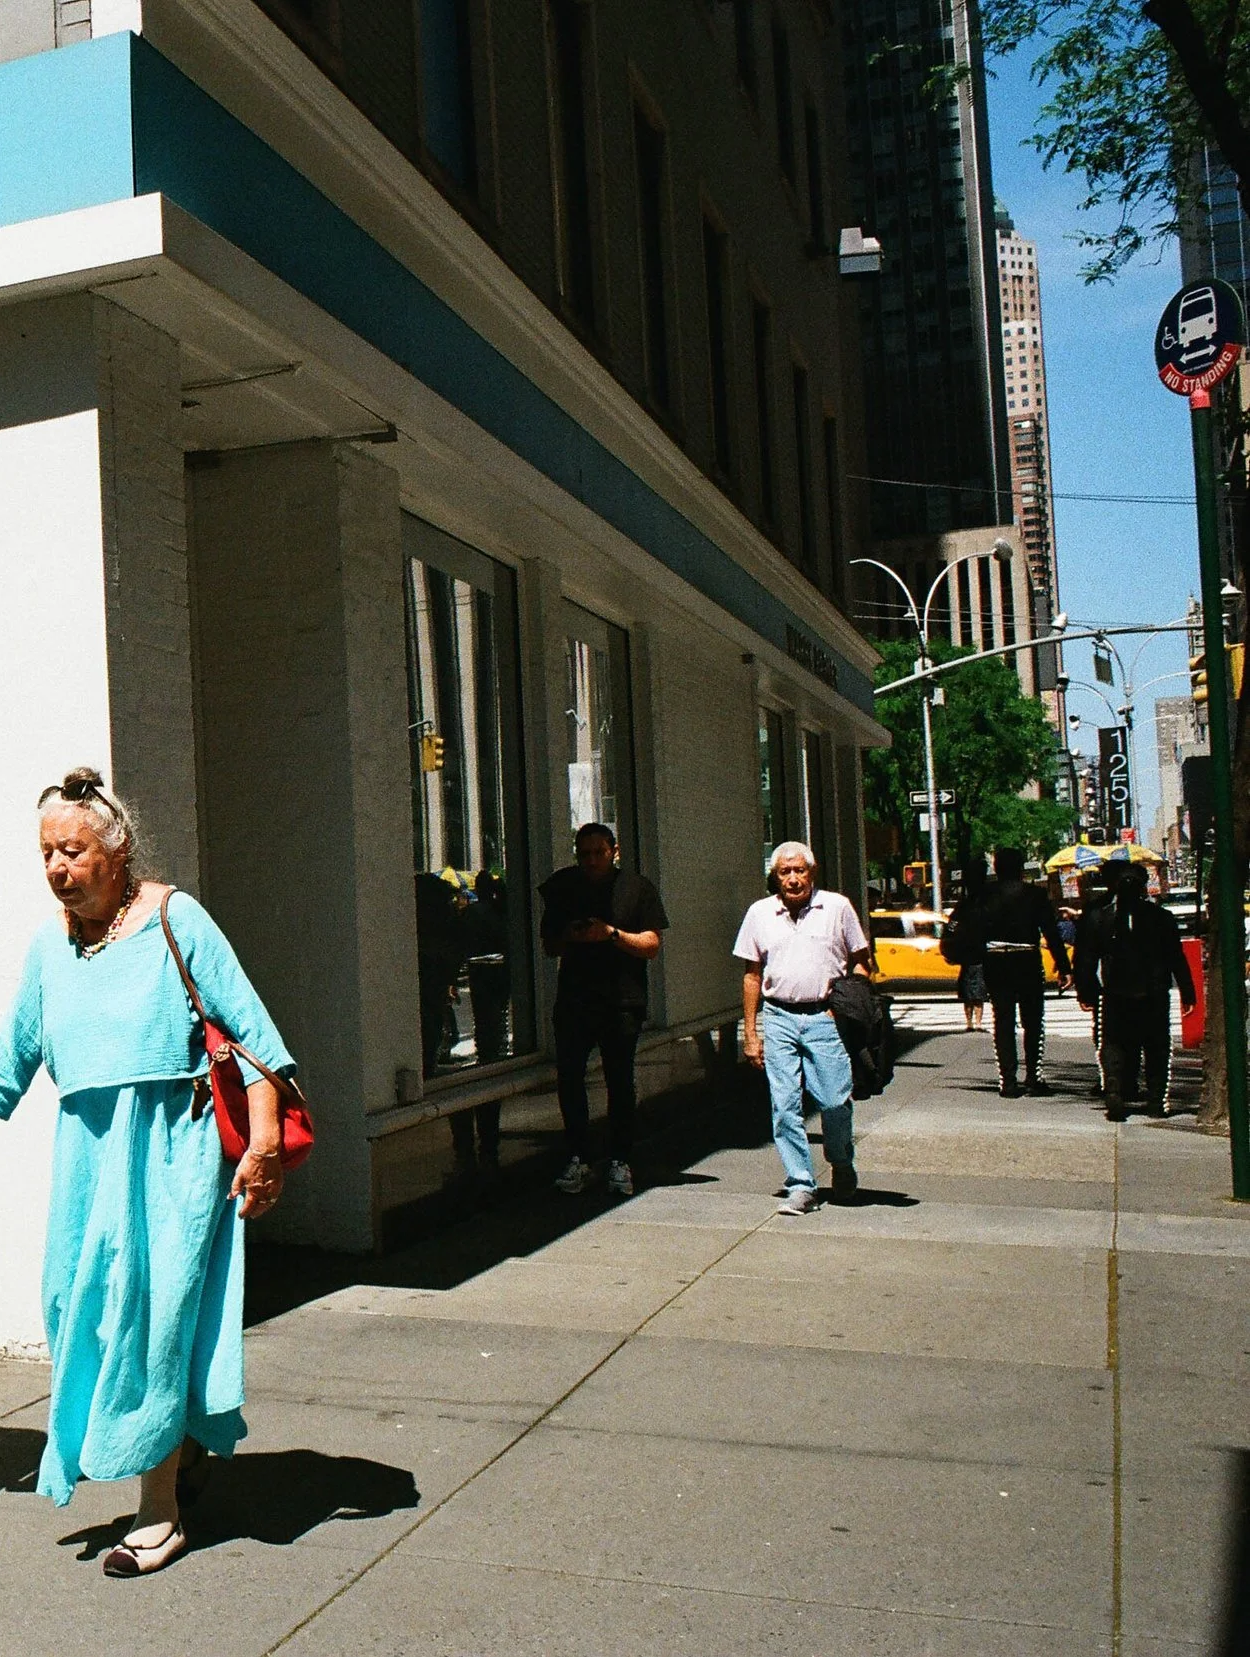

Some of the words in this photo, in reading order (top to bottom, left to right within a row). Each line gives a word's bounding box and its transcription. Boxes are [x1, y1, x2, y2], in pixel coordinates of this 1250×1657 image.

[1164, 371, 1180, 389] NO
[1182, 350, 1233, 391] STANDING
[1110, 729, 1129, 826] 1251
